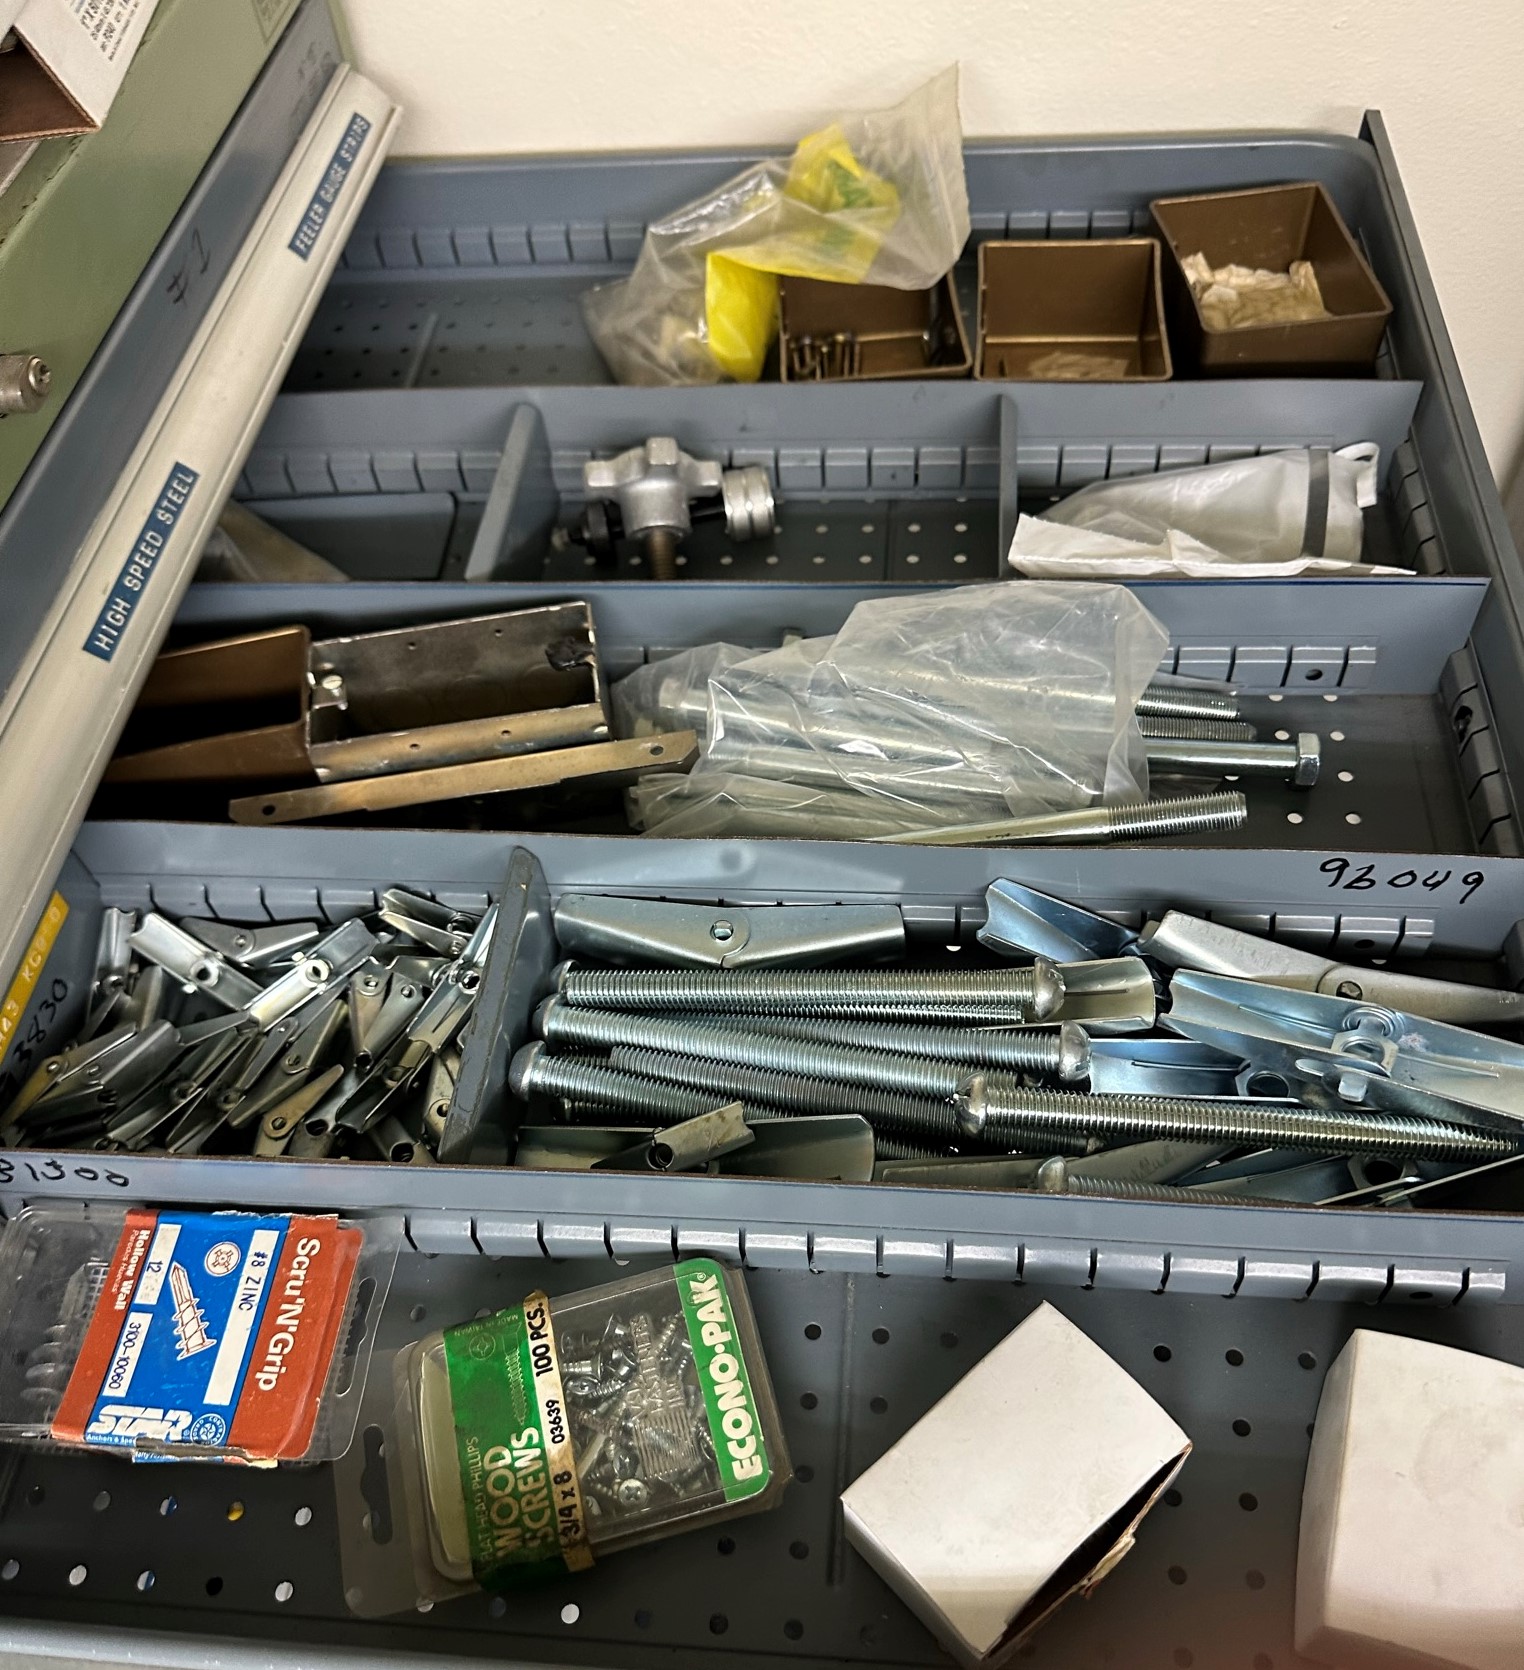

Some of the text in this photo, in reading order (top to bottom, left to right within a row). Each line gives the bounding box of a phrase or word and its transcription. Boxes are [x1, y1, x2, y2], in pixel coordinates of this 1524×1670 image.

[294, 117, 368, 251] FEELER GAUGE STRIPS
[94, 472, 194, 651] HIGH SPEED STEEL
[114, 1229, 151, 1311] Hollow Wall
[146, 1260, 163, 1273] 12
[238, 1251, 268, 1312] #8 ZINC
[254, 1237, 321, 1391] Scru'N'Grip
[109, 1321, 142, 1390] 3100-10060
[87, 1404, 193, 1440] STAR
[466, 1436, 483, 1491] PHILLIPS
[526, 1302, 580, 1537] 3/4 x 8 03639 100 PCS.
[483, 1445, 525, 1558] WOOD
[510, 1426, 557, 1547] SCREWS
